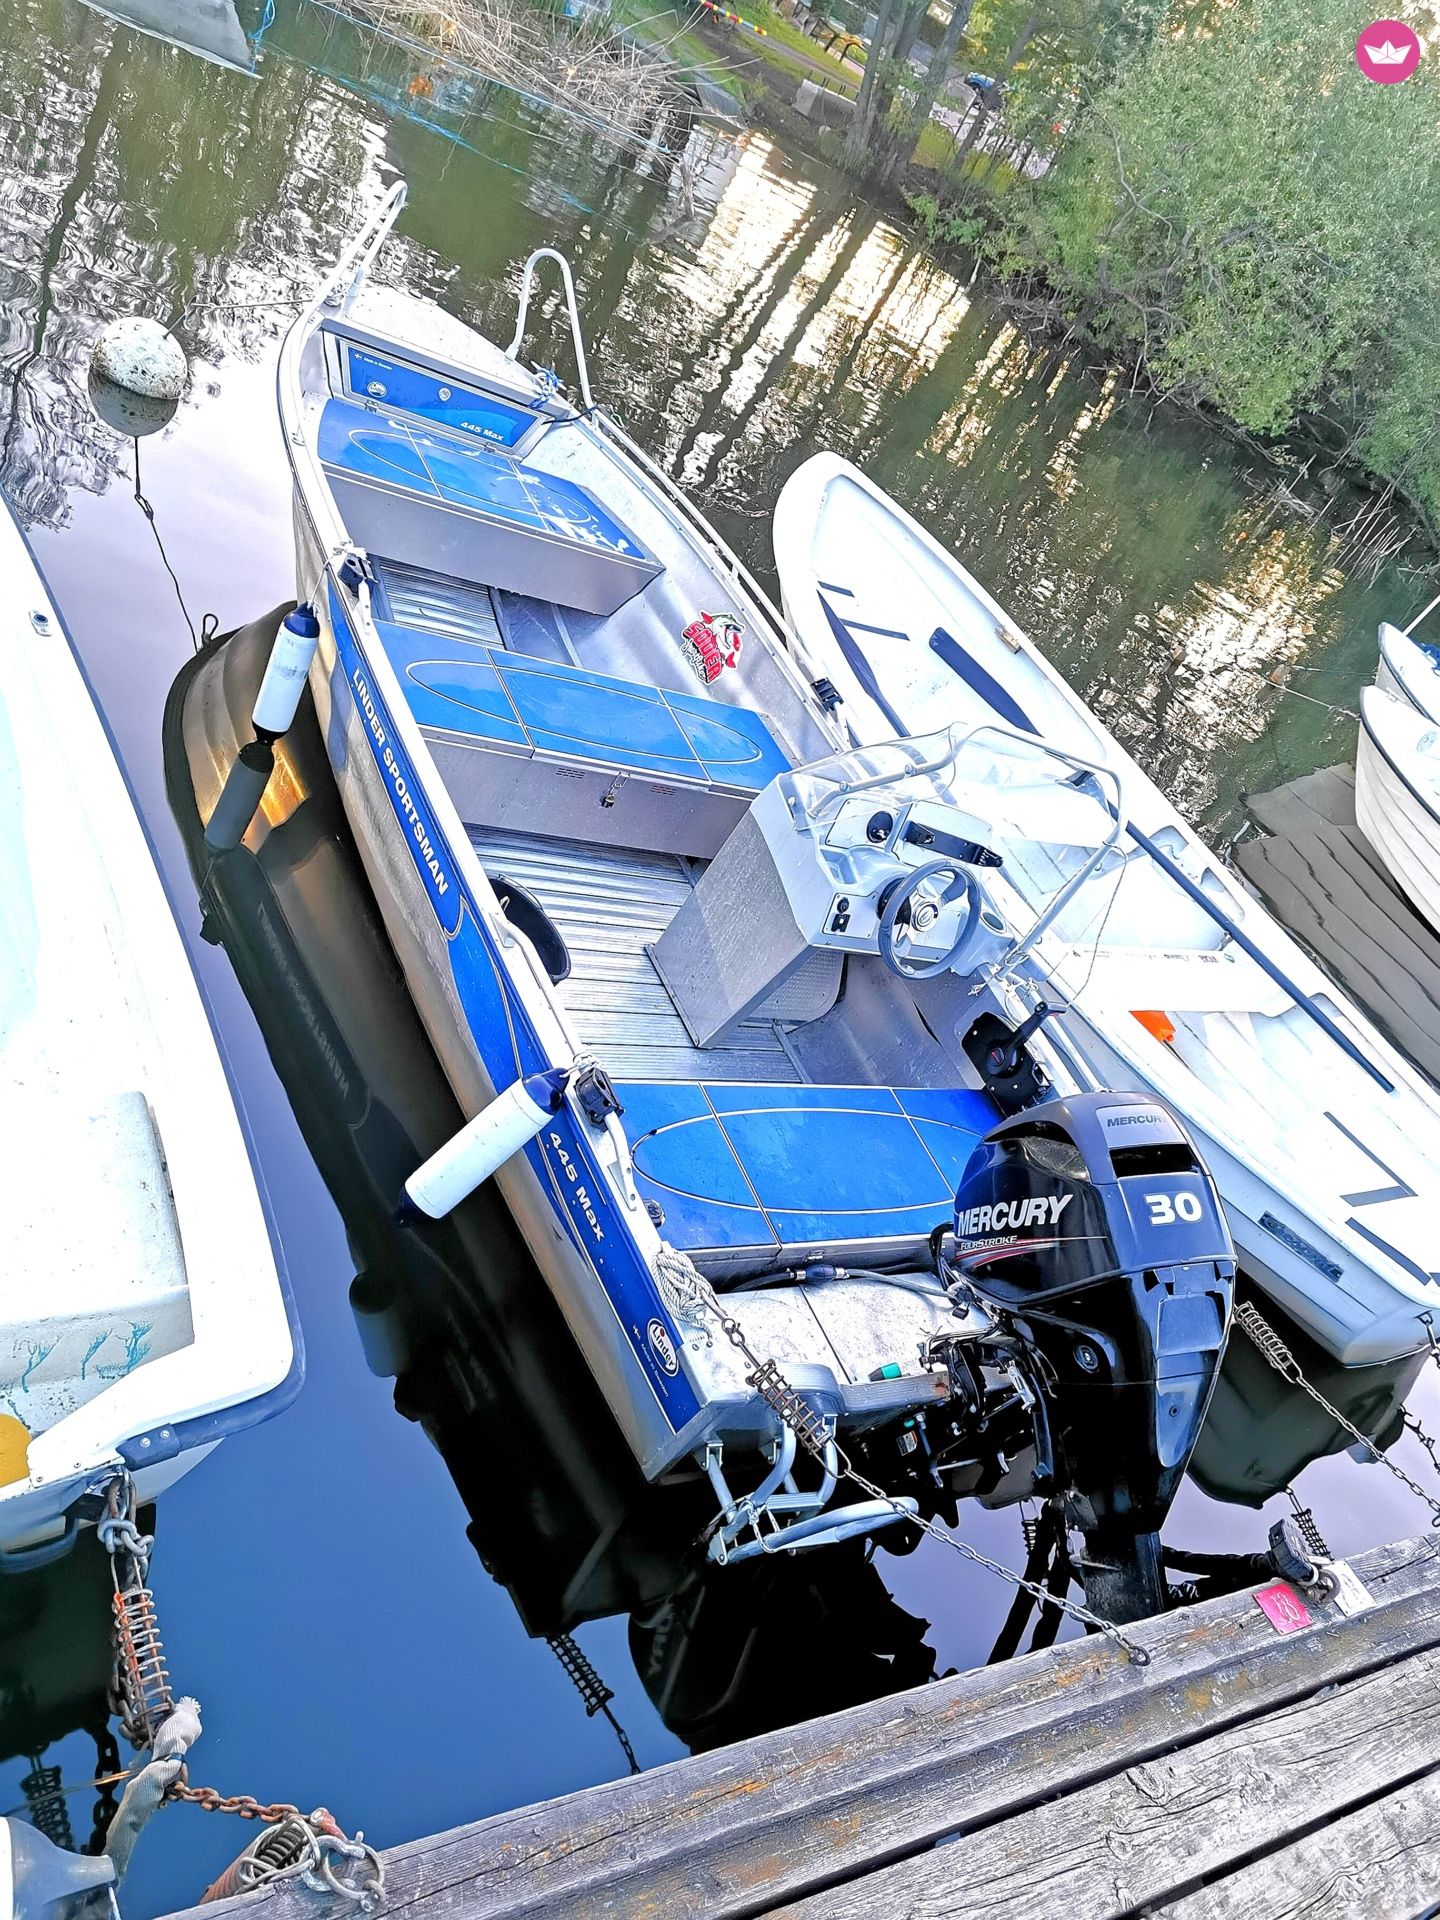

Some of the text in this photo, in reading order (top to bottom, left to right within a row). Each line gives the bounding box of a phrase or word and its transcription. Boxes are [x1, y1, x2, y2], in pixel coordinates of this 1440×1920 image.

[460, 421, 505, 442] 445 Max
[352, 668, 448, 896] LINDER SPORTSMAN
[549, 1132, 605, 1243] 445 Max
[1145, 1192, 1202, 1225] 30
[957, 1194, 1074, 1237] MERCURY
[652, 1326, 675, 1367] Linder
